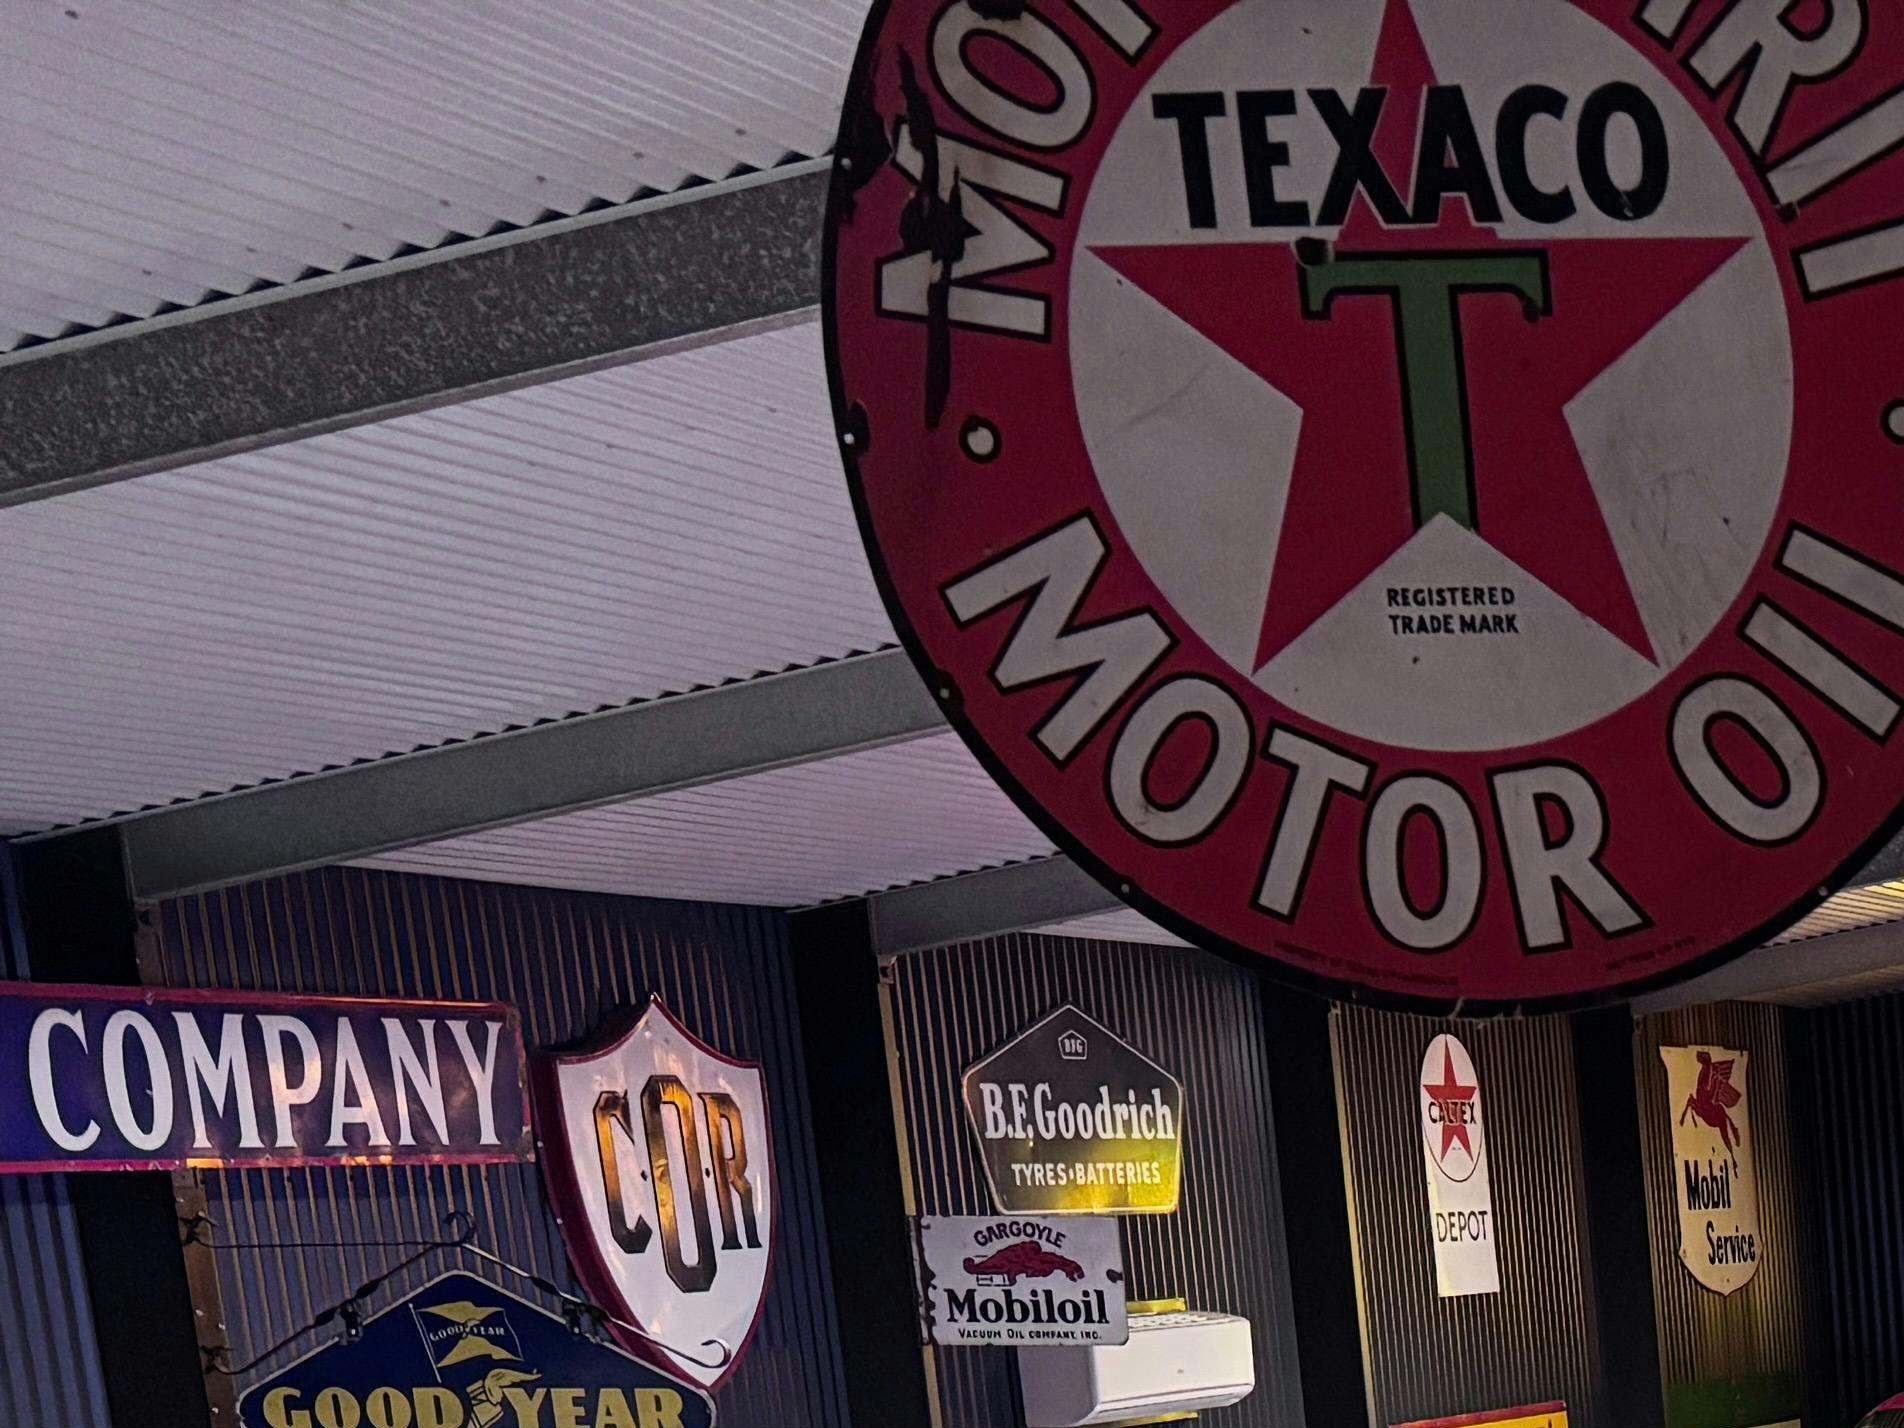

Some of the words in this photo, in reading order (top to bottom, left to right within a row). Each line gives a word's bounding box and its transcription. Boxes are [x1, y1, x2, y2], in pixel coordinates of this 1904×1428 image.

[1152, 81, 1670, 232] TEXACO
[1385, 586, 1517, 609] REGISTERED
[1388, 612, 1454, 635] TRADE
[1458, 612, 1520, 636] MARK
[940, 508, 1651, 955] MOTOR
[27, 1009, 503, 1152] COMPANY
[1427, 1098, 1477, 1127] CALTEX
[1011, 1163, 1067, 1187] TYRES
[1075, 1161, 1161, 1186] BATTERIES
[1684, 1158, 1732, 1211] Mobil
[973, 1220, 1066, 1250] GARGOYLE
[1436, 1209, 1488, 1244] DEPOT
[1706, 1220, 1756, 1266] Service
[943, 1287, 1110, 1325] Mobiloil
[958, 1328, 1002, 1340] VACUUM
[1007, 1328, 1026, 1339] OIL
[1029, 1329, 1076, 1341] COMPANY
